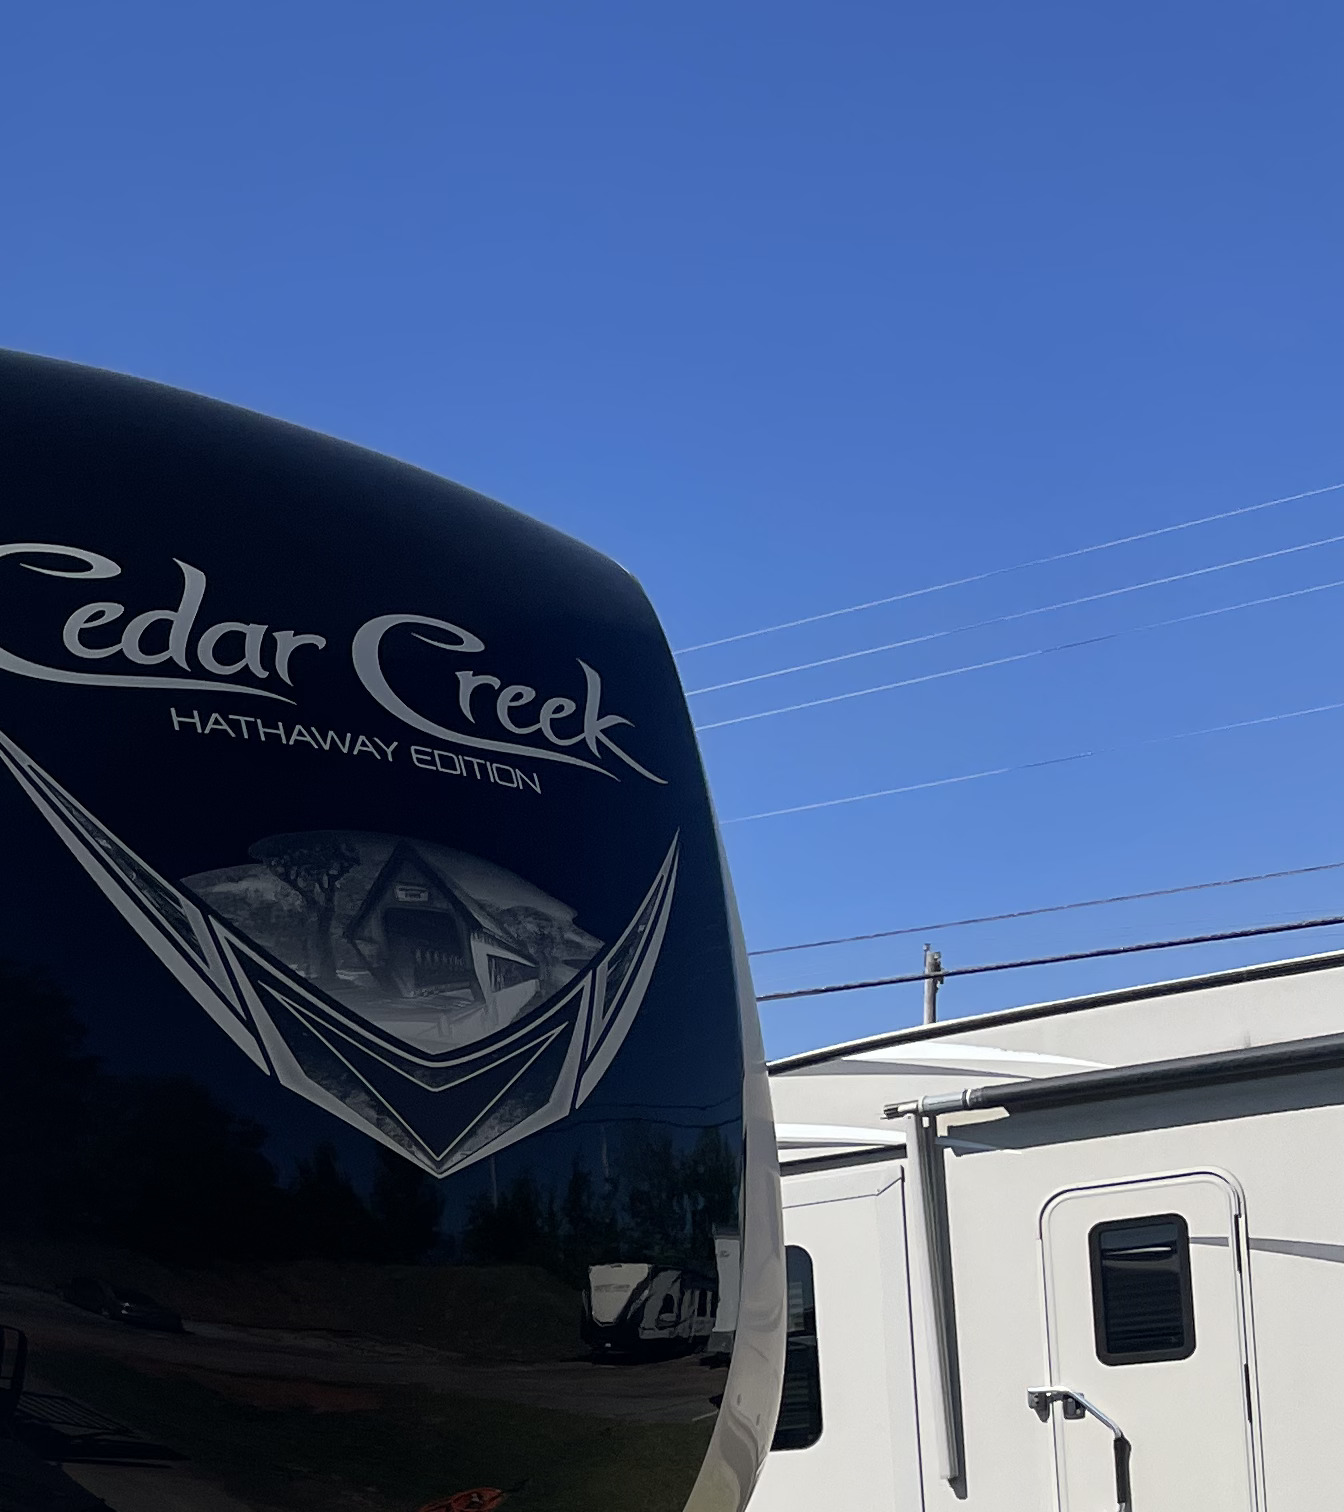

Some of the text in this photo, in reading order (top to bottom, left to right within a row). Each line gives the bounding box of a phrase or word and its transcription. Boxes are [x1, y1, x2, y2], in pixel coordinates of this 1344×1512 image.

[169, 706, 543, 795] HATHAWAY EDITION
[351, 612, 669, 786] Creek
